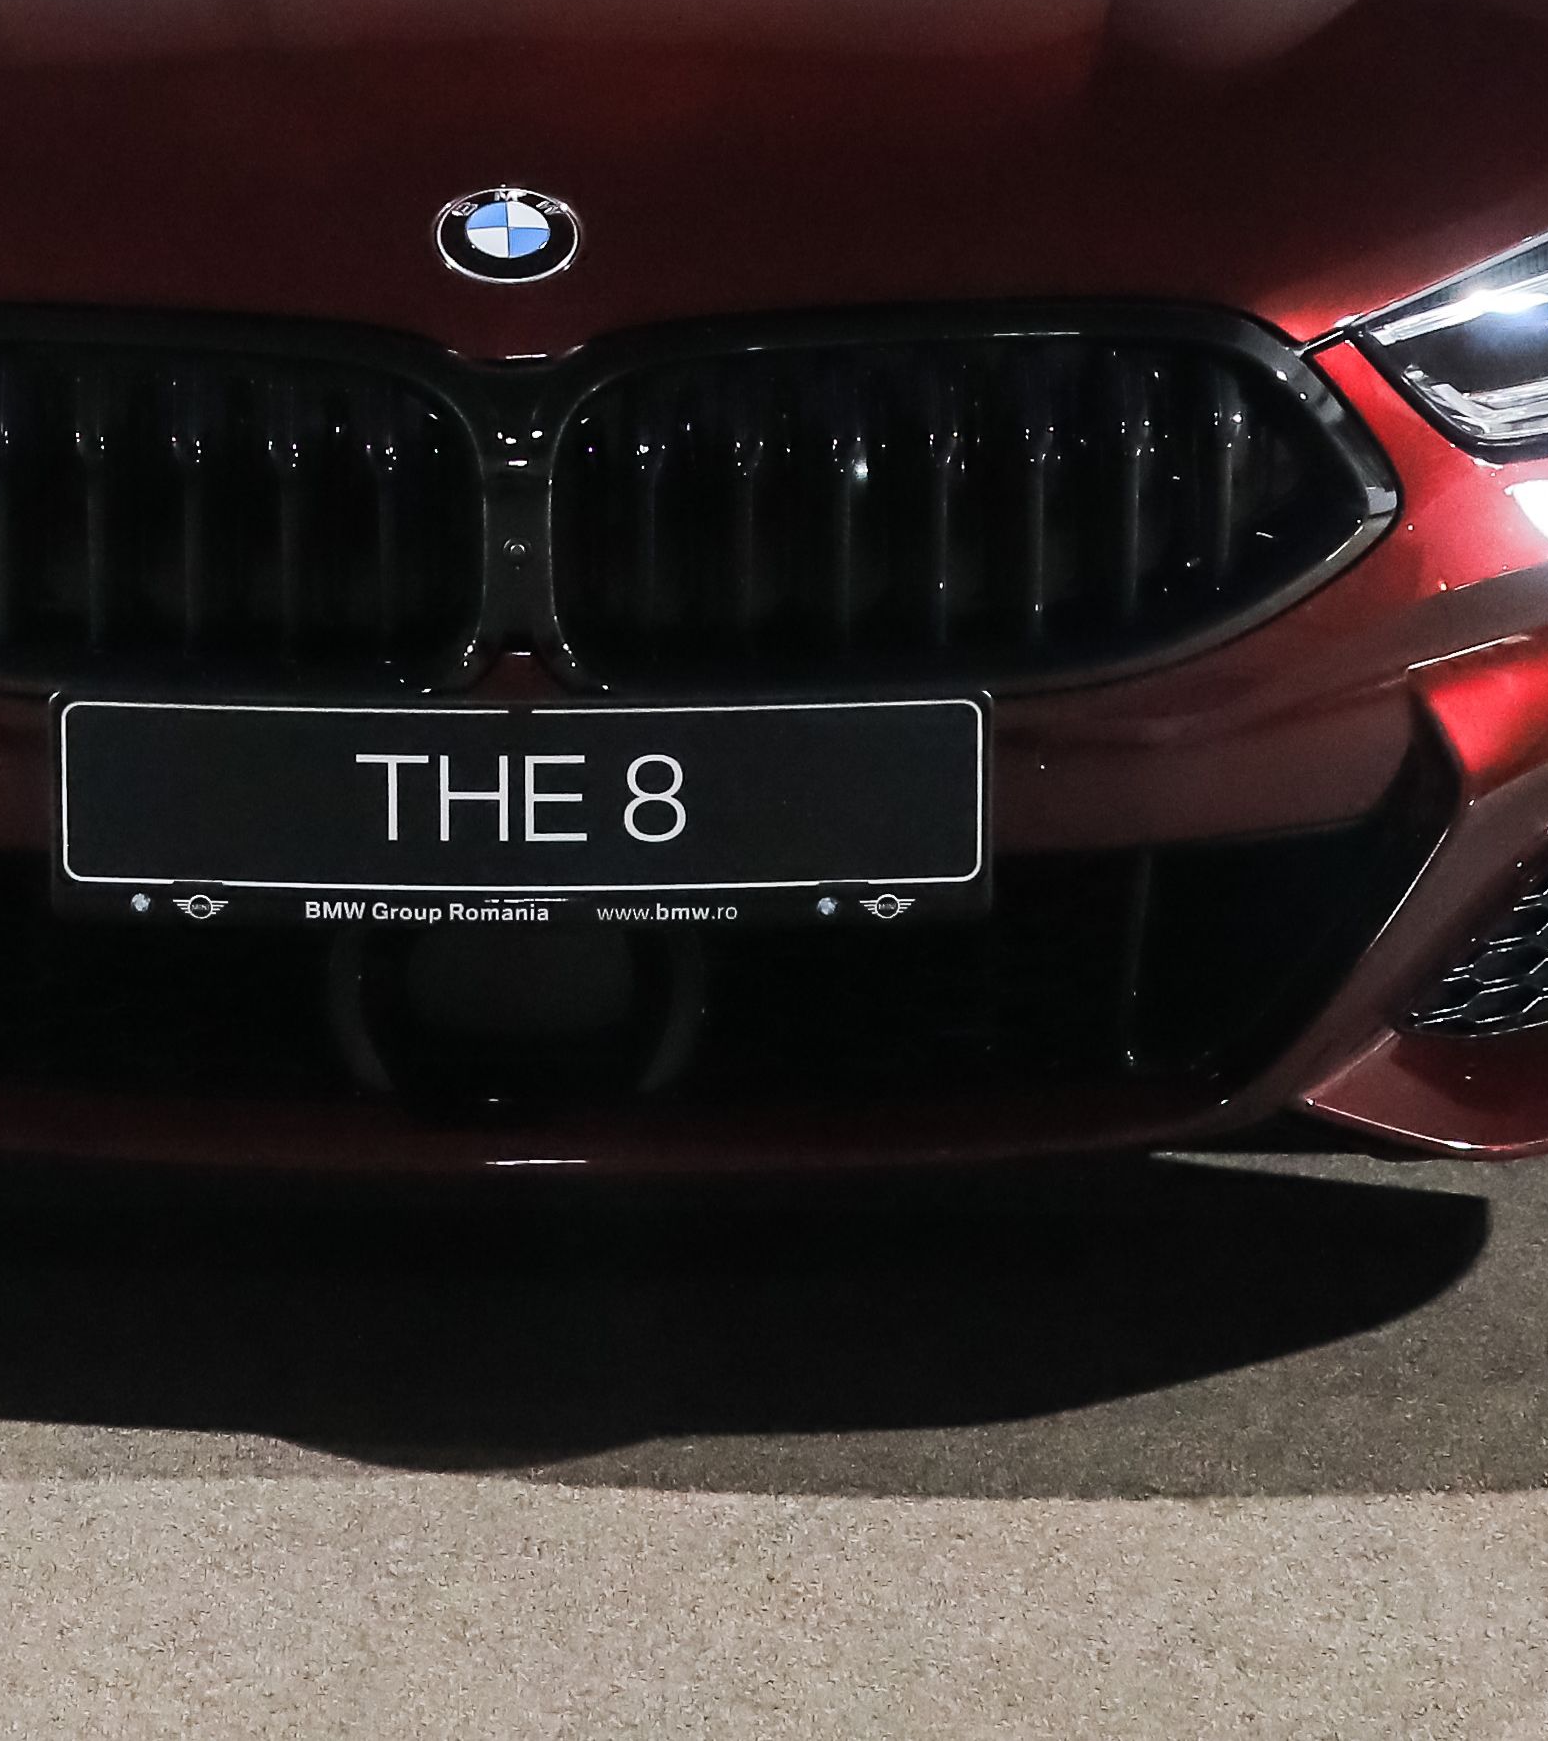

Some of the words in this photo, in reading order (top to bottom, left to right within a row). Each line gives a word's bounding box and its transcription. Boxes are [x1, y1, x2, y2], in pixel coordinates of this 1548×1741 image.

[355, 753, 588, 842] THE
[623, 754, 687, 843] 8
[305, 901, 366, 920] BMW
[371, 901, 443, 924] Group
[449, 902, 550, 922] Romania
[596, 902, 738, 921] www.bmw.ro
